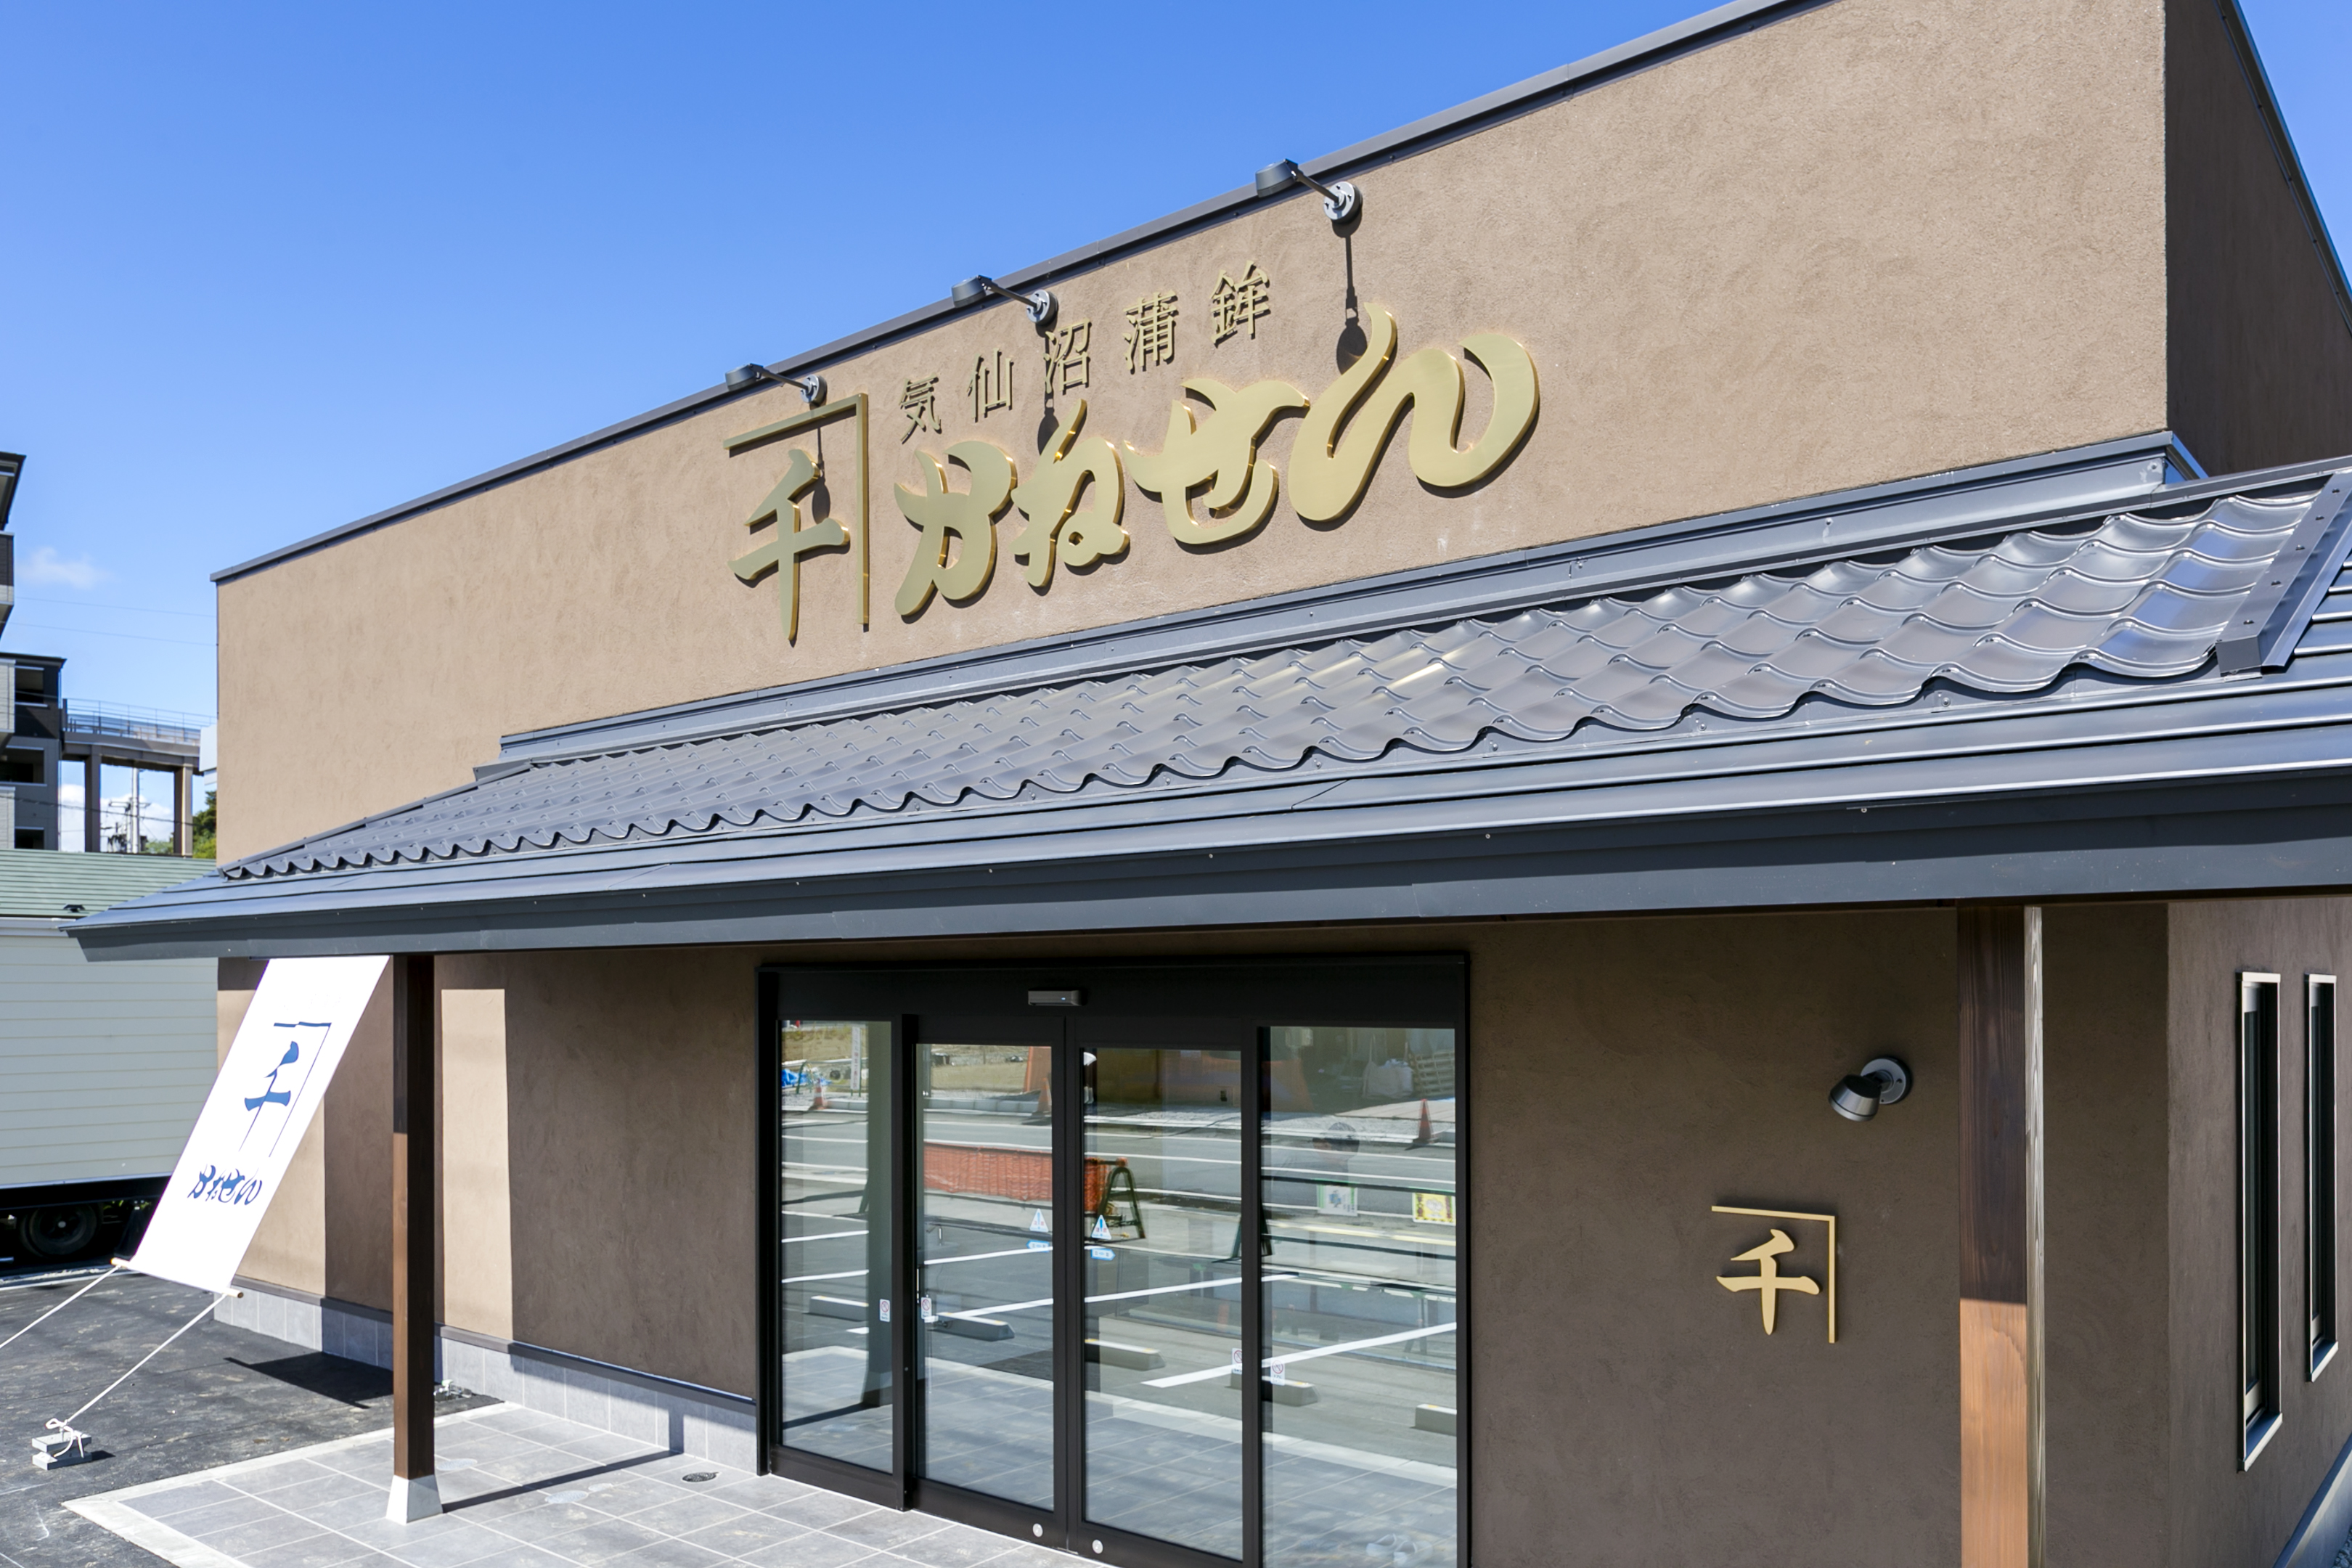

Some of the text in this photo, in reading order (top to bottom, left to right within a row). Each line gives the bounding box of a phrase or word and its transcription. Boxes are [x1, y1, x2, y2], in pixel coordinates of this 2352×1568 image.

[894, 301, 1540, 617] かねせん
[899, 259, 1271, 444] 気仙沼蒲鉾
